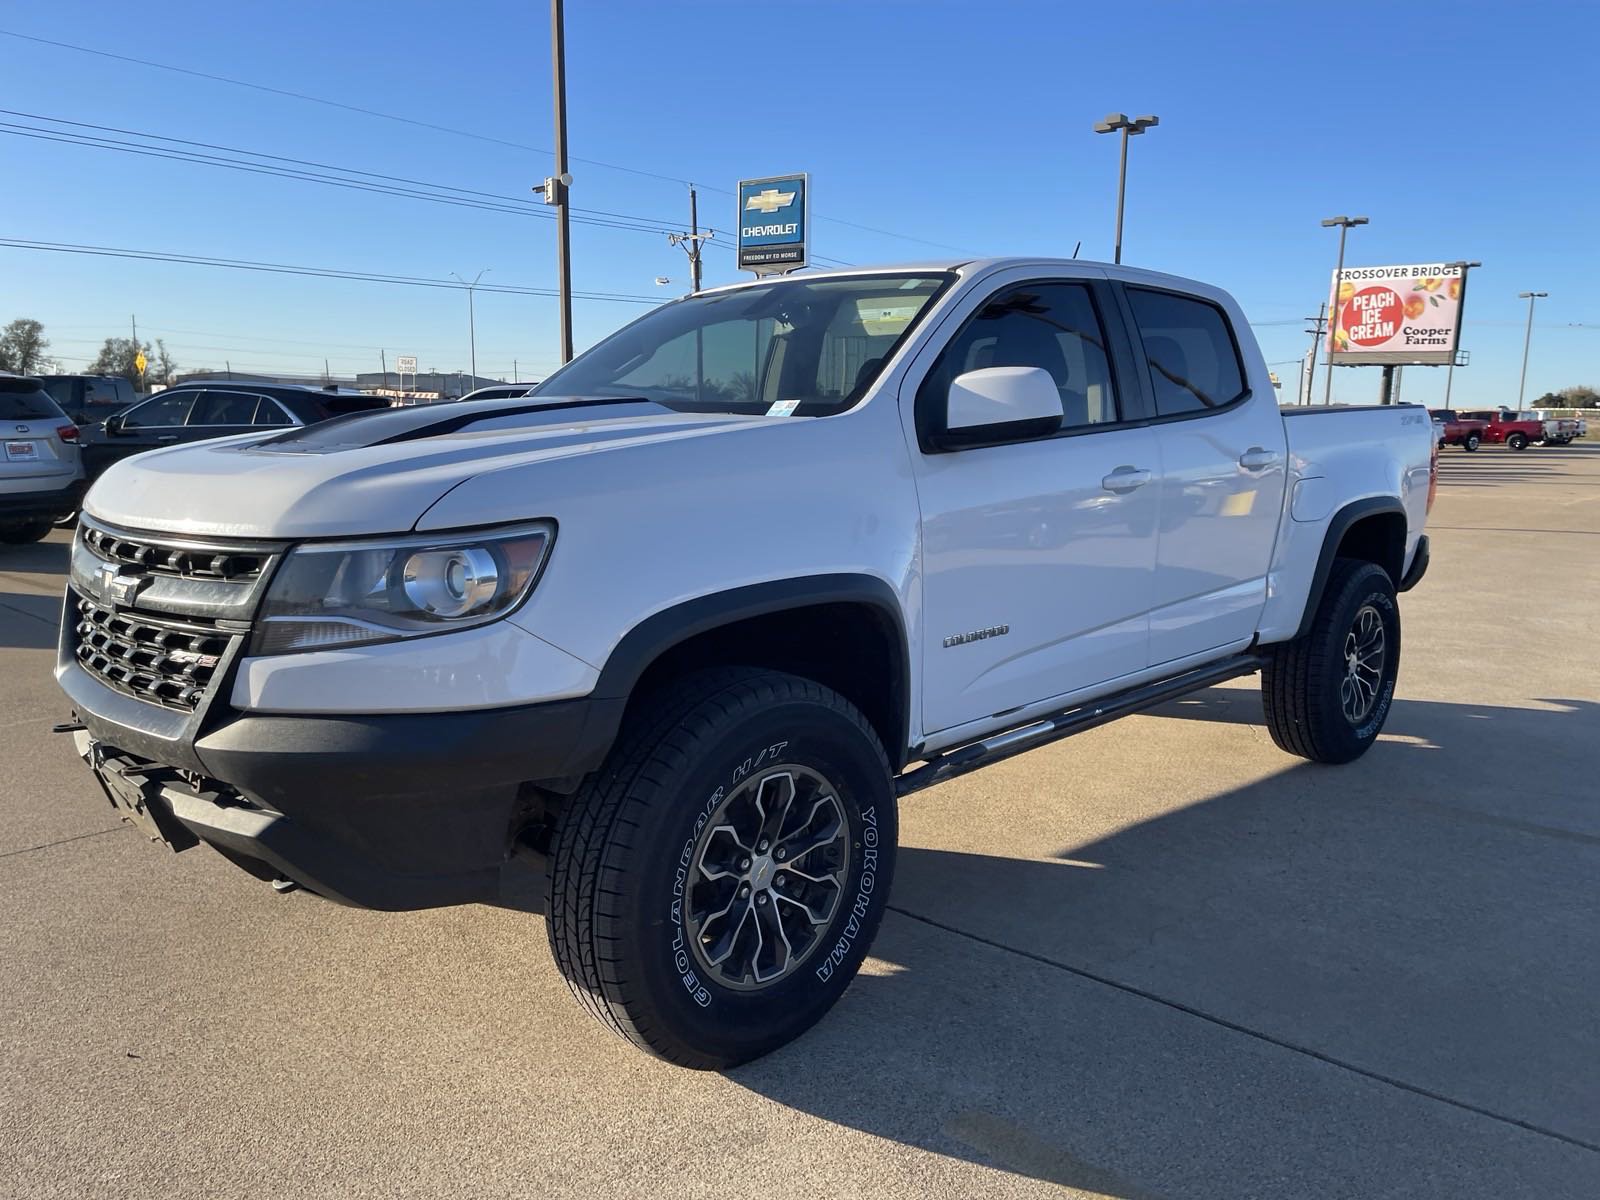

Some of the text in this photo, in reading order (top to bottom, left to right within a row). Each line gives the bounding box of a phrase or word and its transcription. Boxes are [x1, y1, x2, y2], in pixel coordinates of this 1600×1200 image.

[742, 223, 798, 238] CHEVROLET
[1336, 266, 1459, 280] CROSSOVER BRIDGE
[1353, 291, 1395, 311] PEACH
[1362, 308, 1382, 325] ICE
[1350, 321, 1394, 341] CREAM
[1403, 326, 1451, 336] Cooper
[1405, 336, 1447, 345] Farms
[943, 624, 1009, 648] COLORADO
[671, 741, 788, 1008] GEOLANDAR H/T
[816, 806, 879, 983] YOKOHAMA
